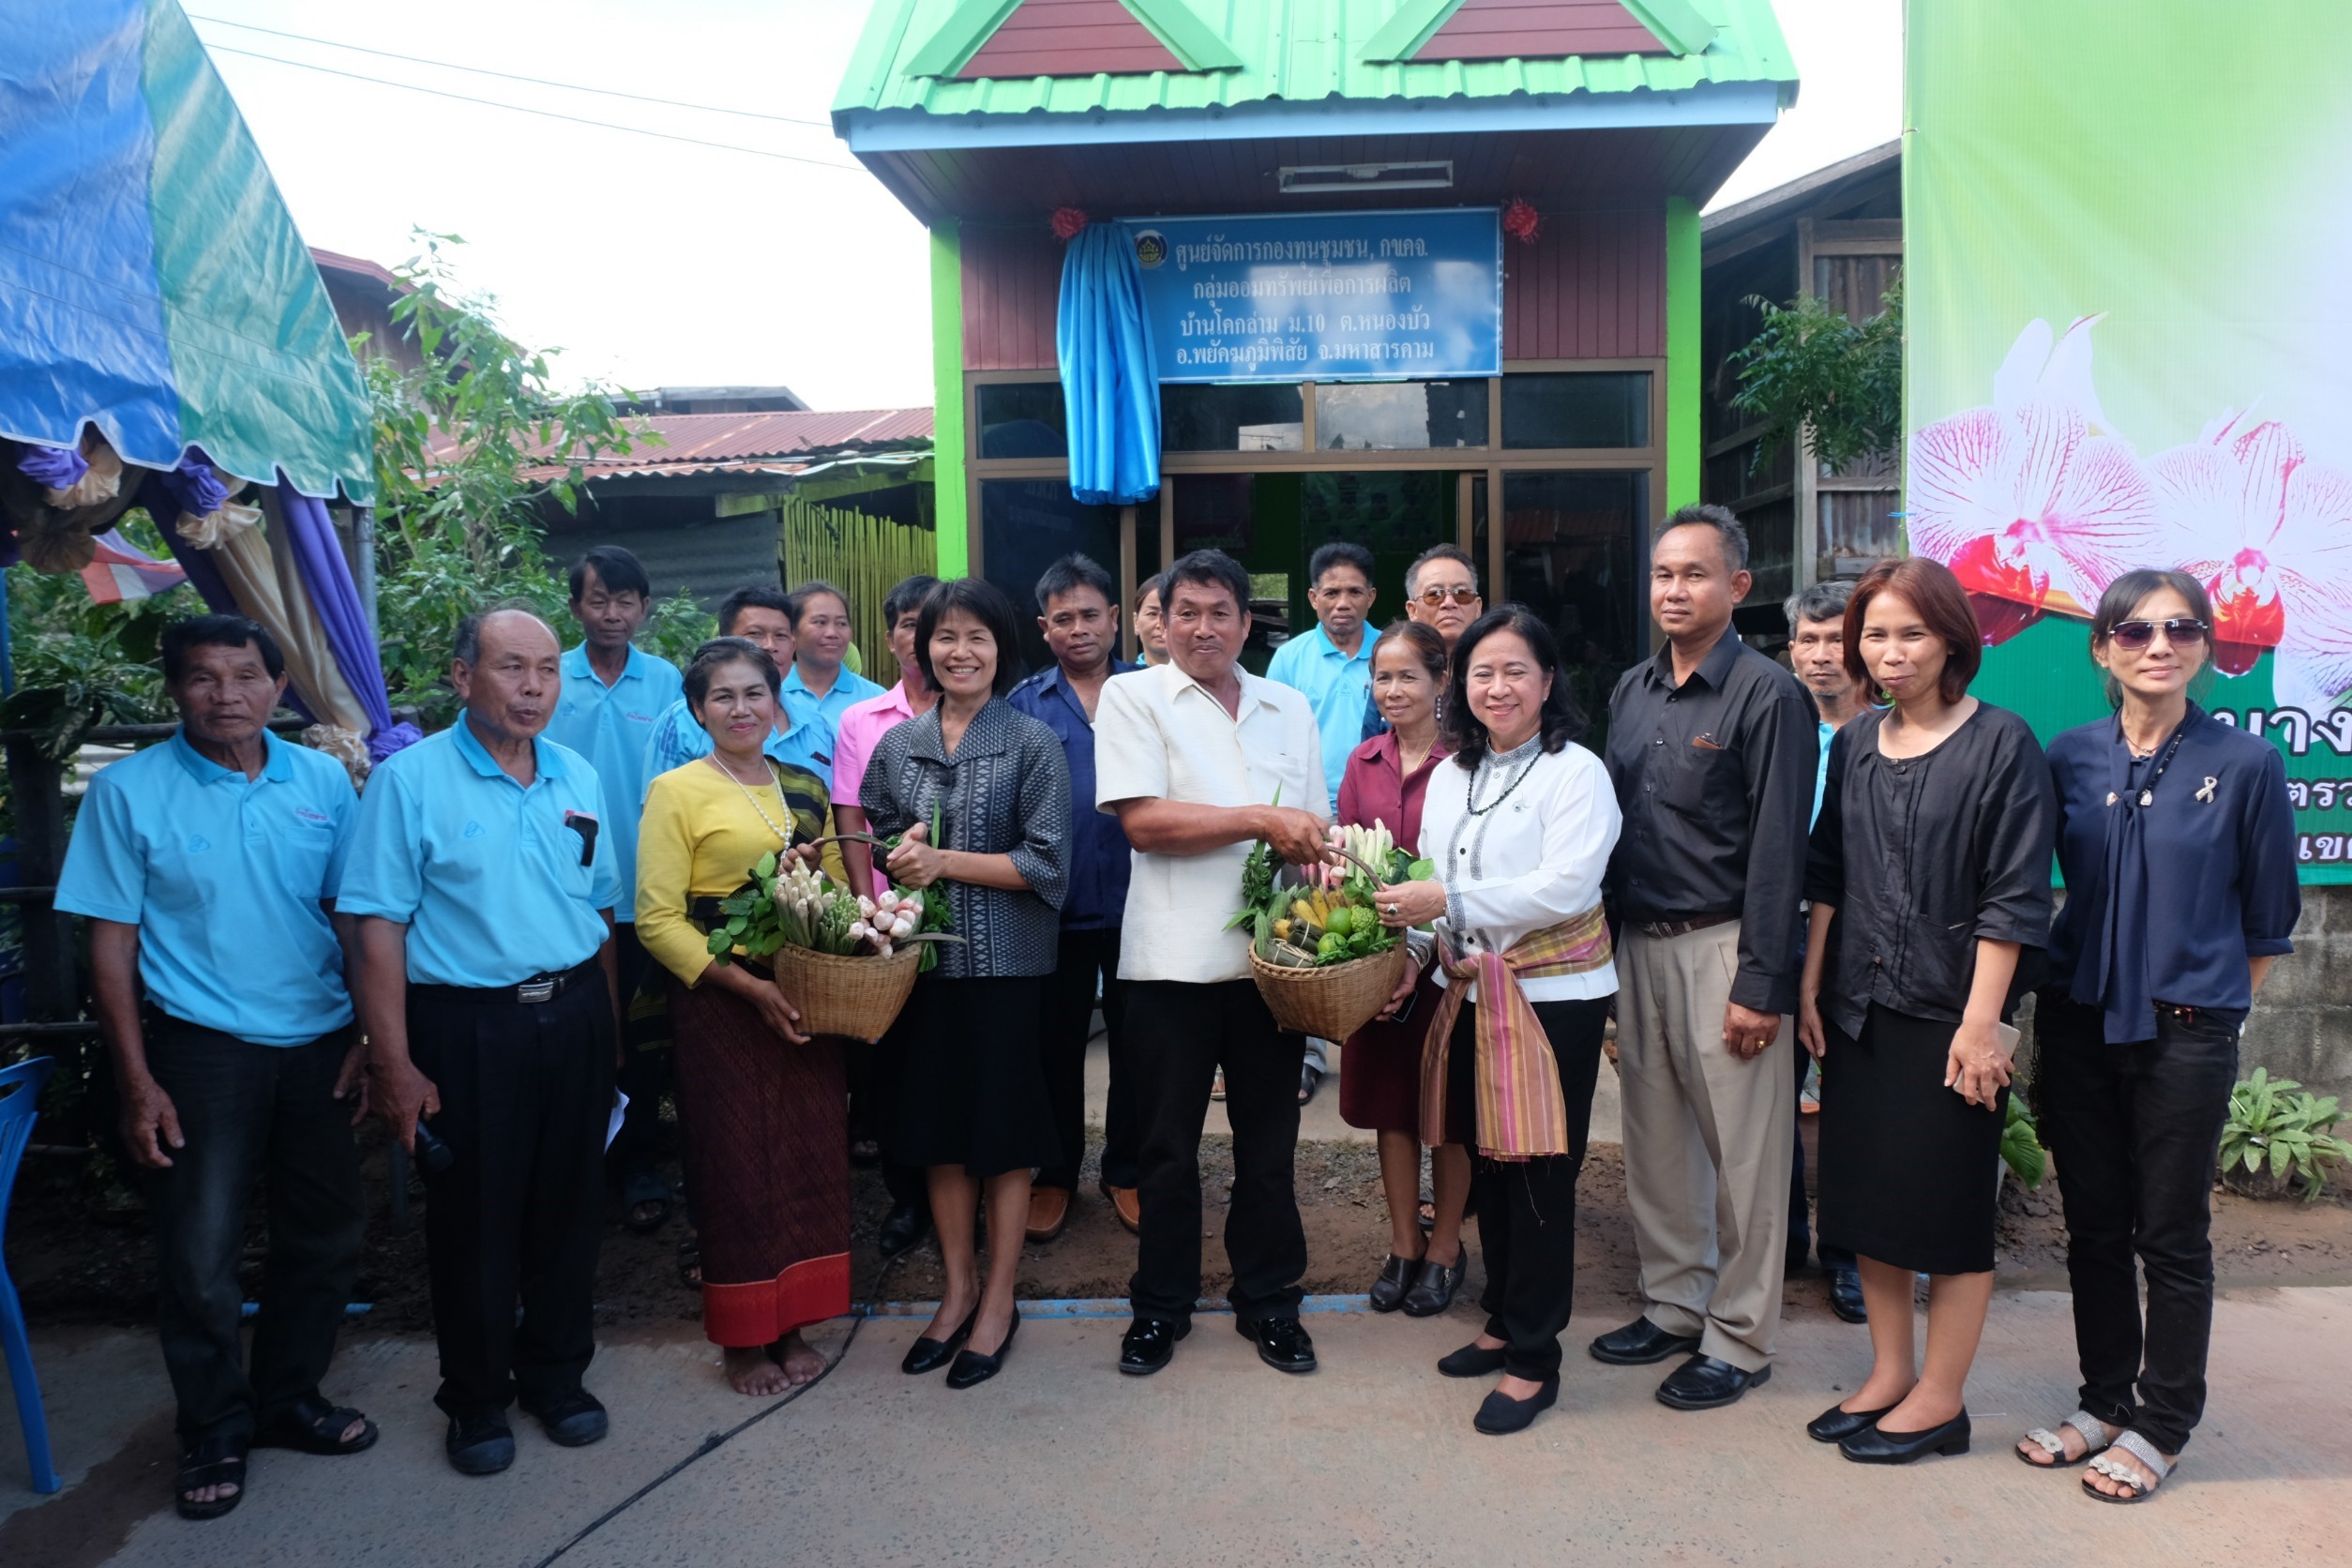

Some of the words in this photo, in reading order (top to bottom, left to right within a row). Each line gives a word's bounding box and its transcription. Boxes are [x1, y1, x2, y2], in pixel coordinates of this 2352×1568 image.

[1181, 309, 1277, 336] บ้านโคกล่าม
[1289, 313, 1325, 333] ม.10
[1340, 304, 1430, 332] ต.หนองบัว
[1177, 337, 1307, 371] อ.พยัคฆภูมิพิสัย
[1318, 341, 1434, 360] จ.มหาสารคาม
